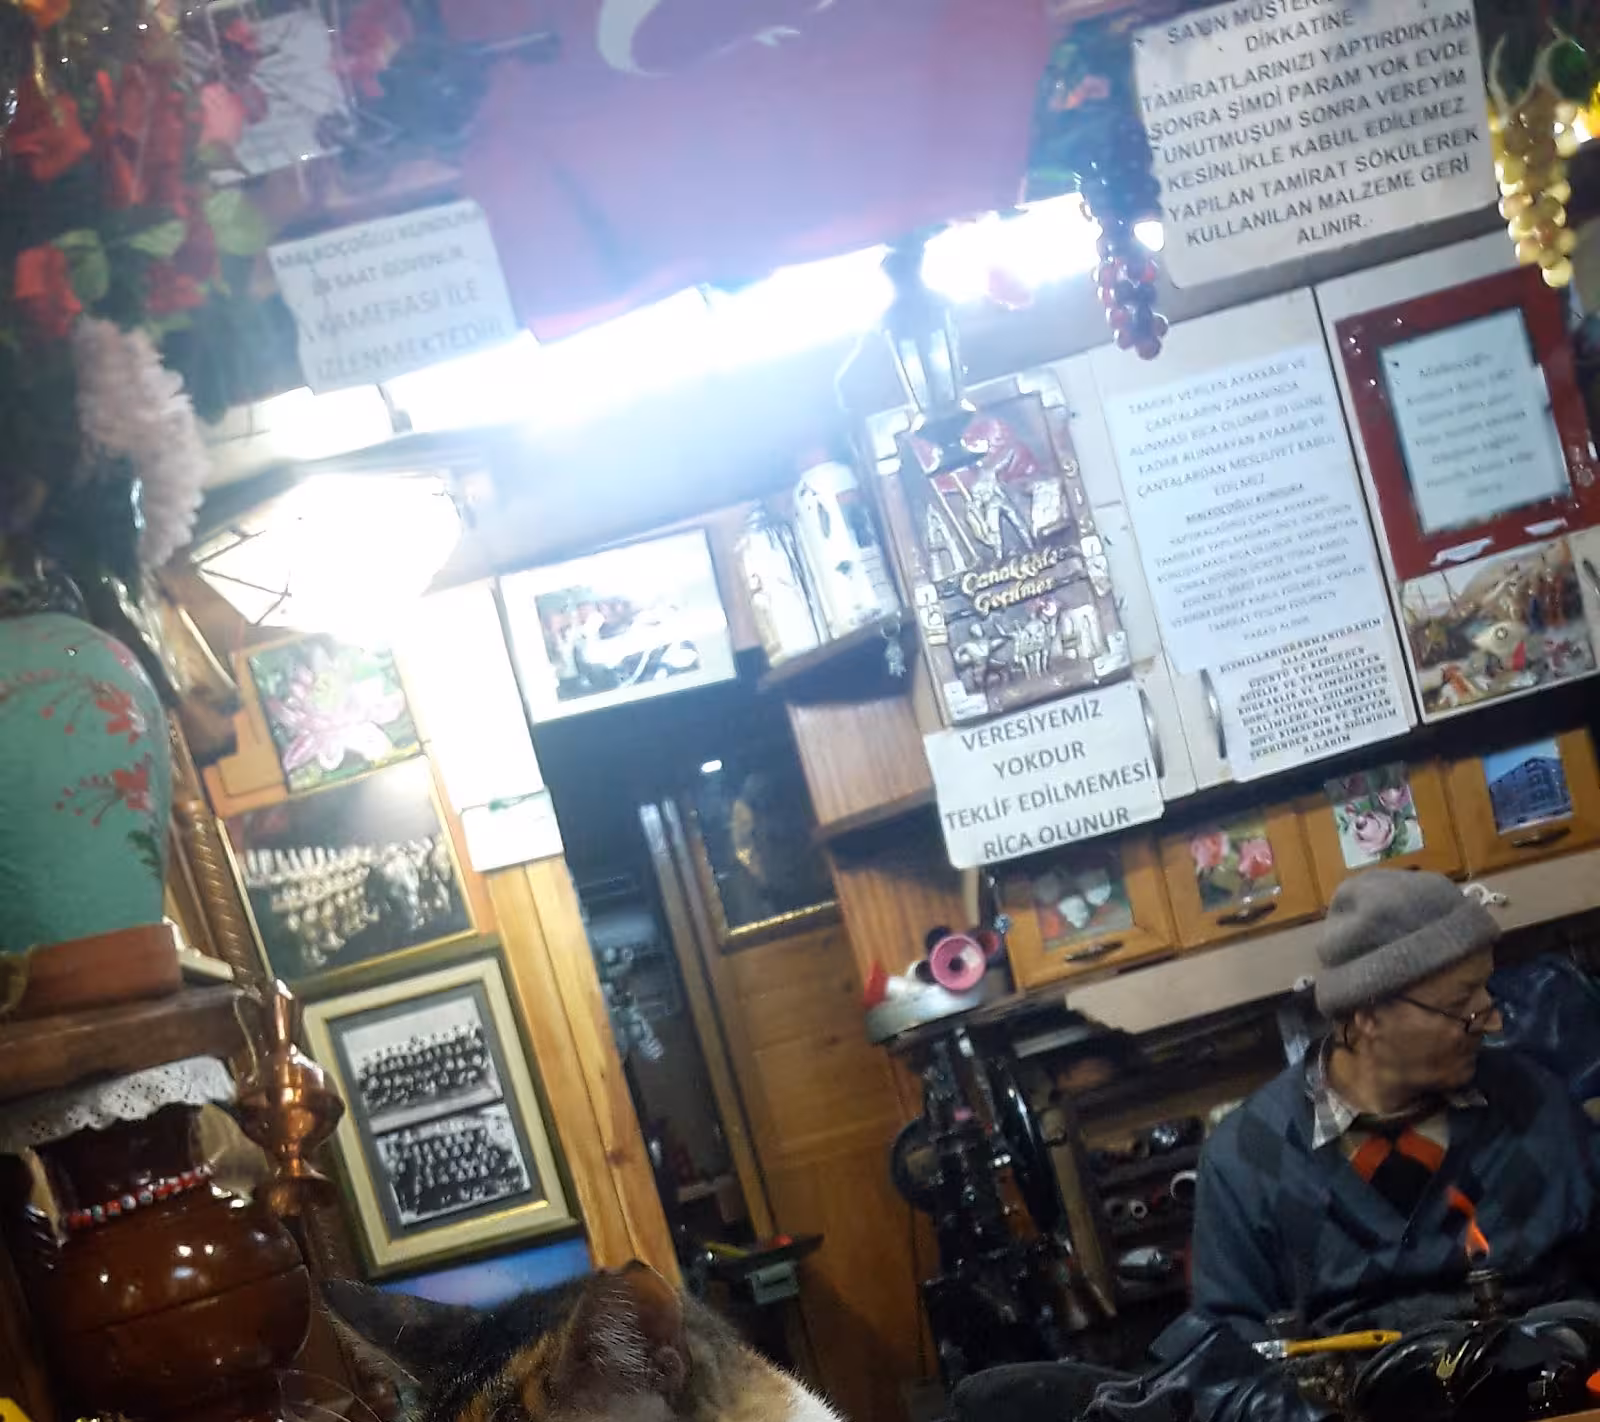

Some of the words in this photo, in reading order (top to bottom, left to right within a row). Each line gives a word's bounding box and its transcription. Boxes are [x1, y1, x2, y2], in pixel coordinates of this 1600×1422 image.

[1146, 107, 1222, 140] SONRA
[1224, 87, 1283, 119] ŞİMDİ
[1286, 68, 1362, 101] PARAM
[1366, 54, 1409, 79] YOK
[1413, 38, 1469, 66] EVDE
[1162, 116, 1293, 165] UNUTMUŞUM
[1296, 95, 1370, 127] SONRA
[1375, 66, 1467, 105] VEREYİM
[1165, 145, 1284, 192] KESİNLİKLE
[1288, 125, 1358, 158] KABUL
[1167, 186, 1254, 222] YAPILAN
[1259, 158, 1349, 197] TAMİRAT
[1185, 199, 1313, 246] KULLANILAN
[1316, 171, 1415, 210] MALZEME
[1418, 154, 1471, 183] GERİ
[959, 695, 1103, 751] VERESİYEMİZ
[992, 740, 1087, 780] YOKDUR
[944, 796, 1011, 830] TEKLİF
[1017, 760, 1152, 811] EDİLMEMESİ
[980, 827, 1033, 859] RİCA
[1036, 807, 1131, 844] OLUNUR
